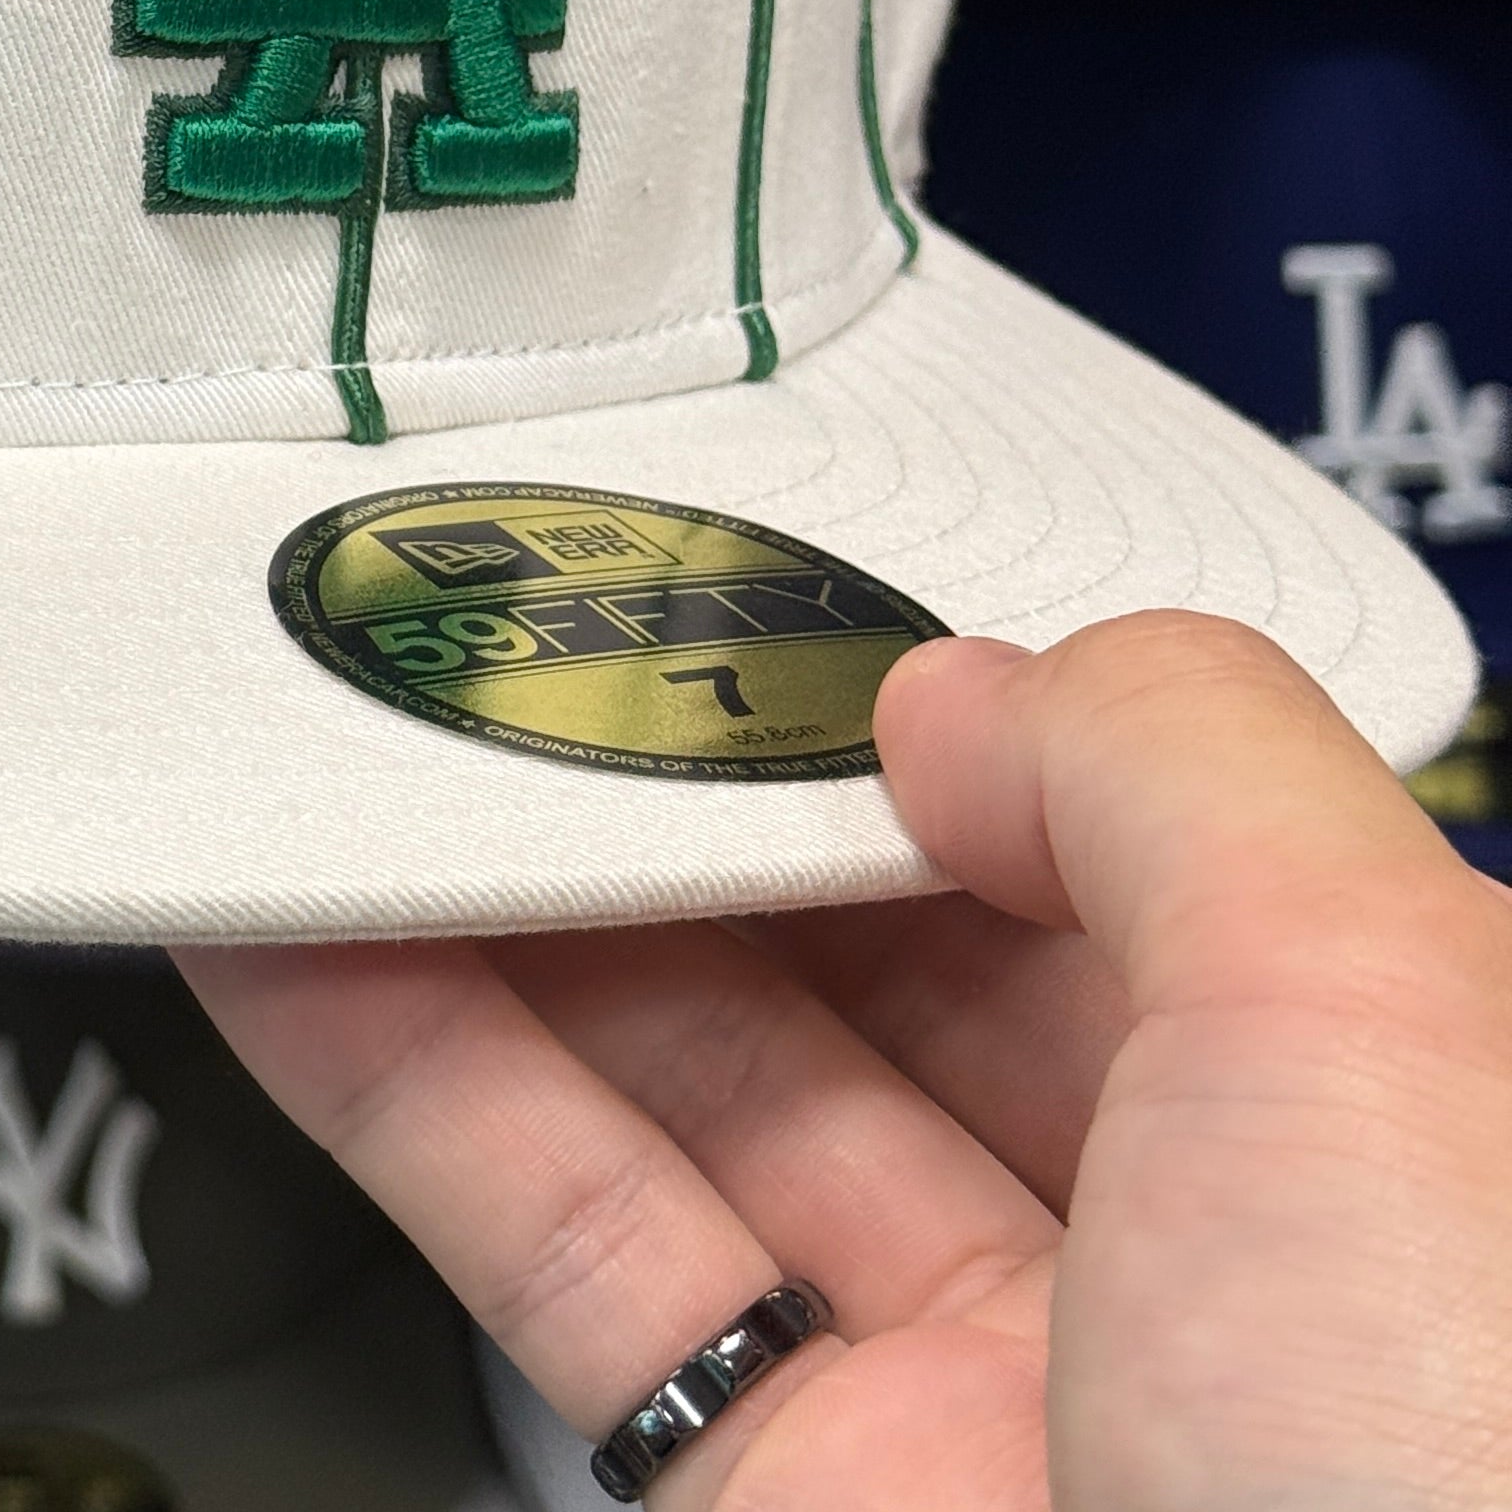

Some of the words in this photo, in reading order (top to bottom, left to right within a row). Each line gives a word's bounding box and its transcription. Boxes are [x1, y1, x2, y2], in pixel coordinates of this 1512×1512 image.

[1283, 243, 1512, 541] LA
[330, 491, 439, 529] ORIGINATORS
[525, 522, 623, 546] NEW
[547, 539, 646, 561] ERA
[367, 580, 853, 671] 59FIFTY
[660, 666, 756, 718] 7
[484, 725, 654, 769] ORIGINATORS
[660, 760, 694, 772] OF
[699, 762, 747, 775] THE
[755, 761, 815, 775] TRUE
